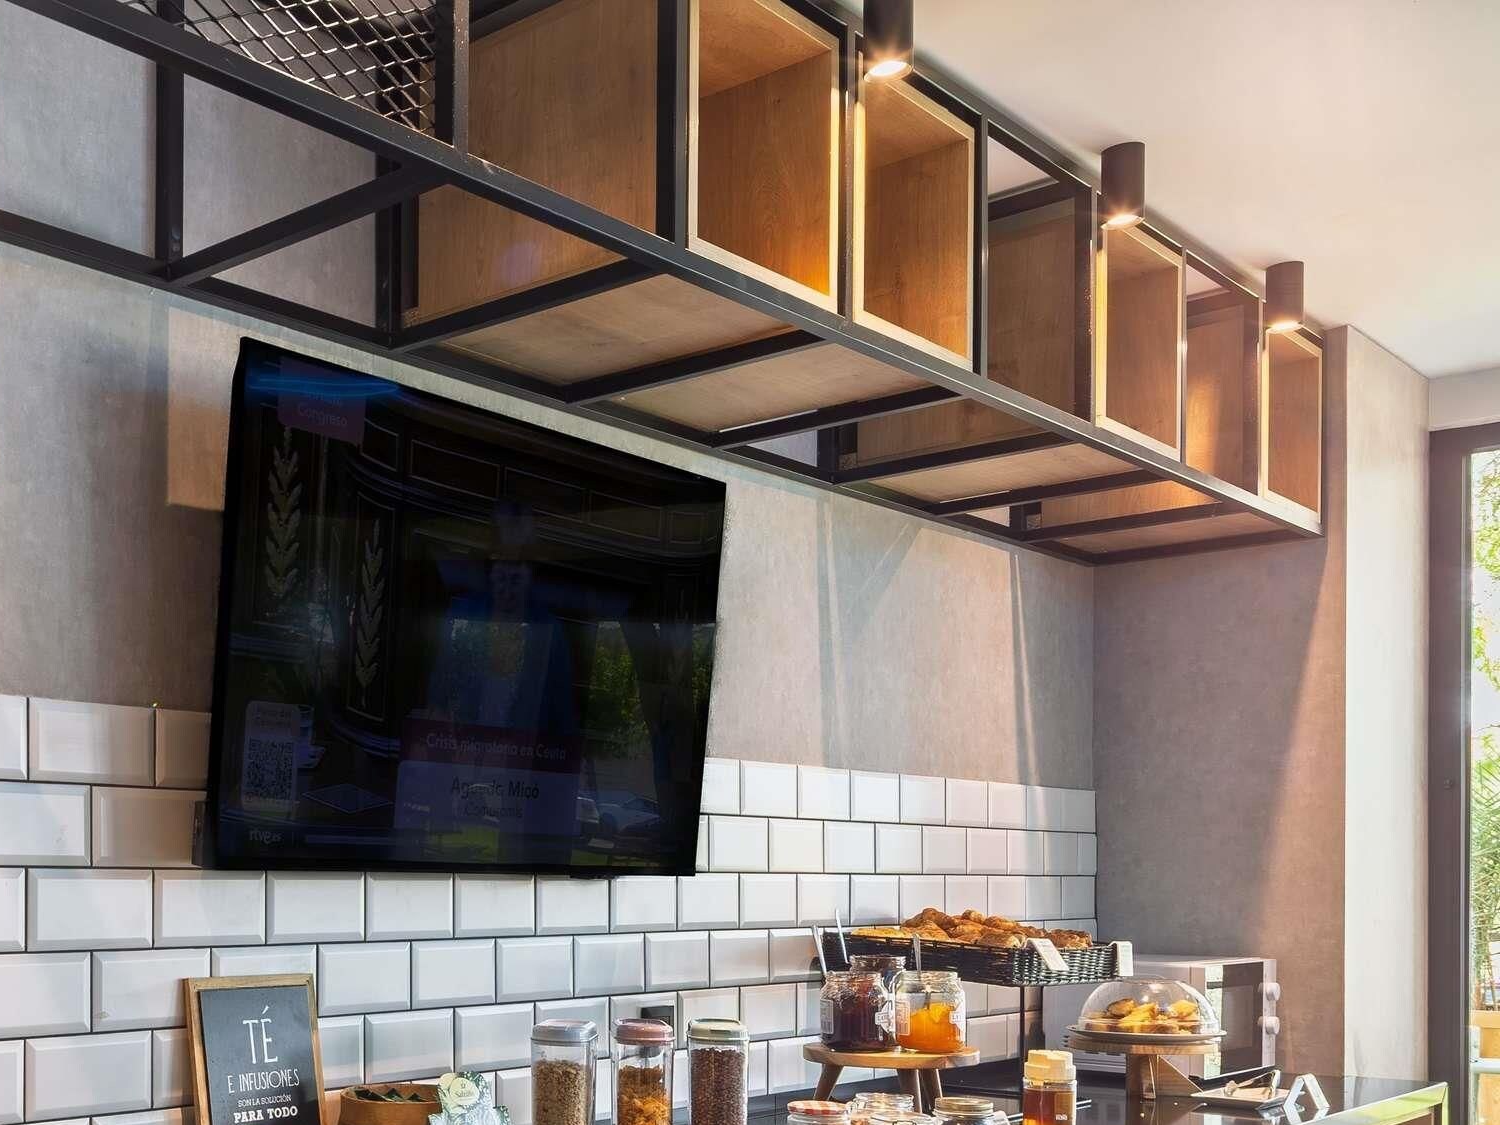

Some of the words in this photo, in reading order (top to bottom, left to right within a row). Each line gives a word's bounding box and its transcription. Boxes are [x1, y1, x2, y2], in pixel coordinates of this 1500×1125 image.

[242, 1005, 278, 1065] TÉ
[227, 1075, 235, 1094] E
[239, 1068, 300, 1092] INFUSIONES
[238, 1099, 252, 1108] SON
[261, 1094, 292, 1105] SOLUCIÓN
[233, 1109, 264, 1124] PARA
[267, 1106, 298, 1119] TODO
